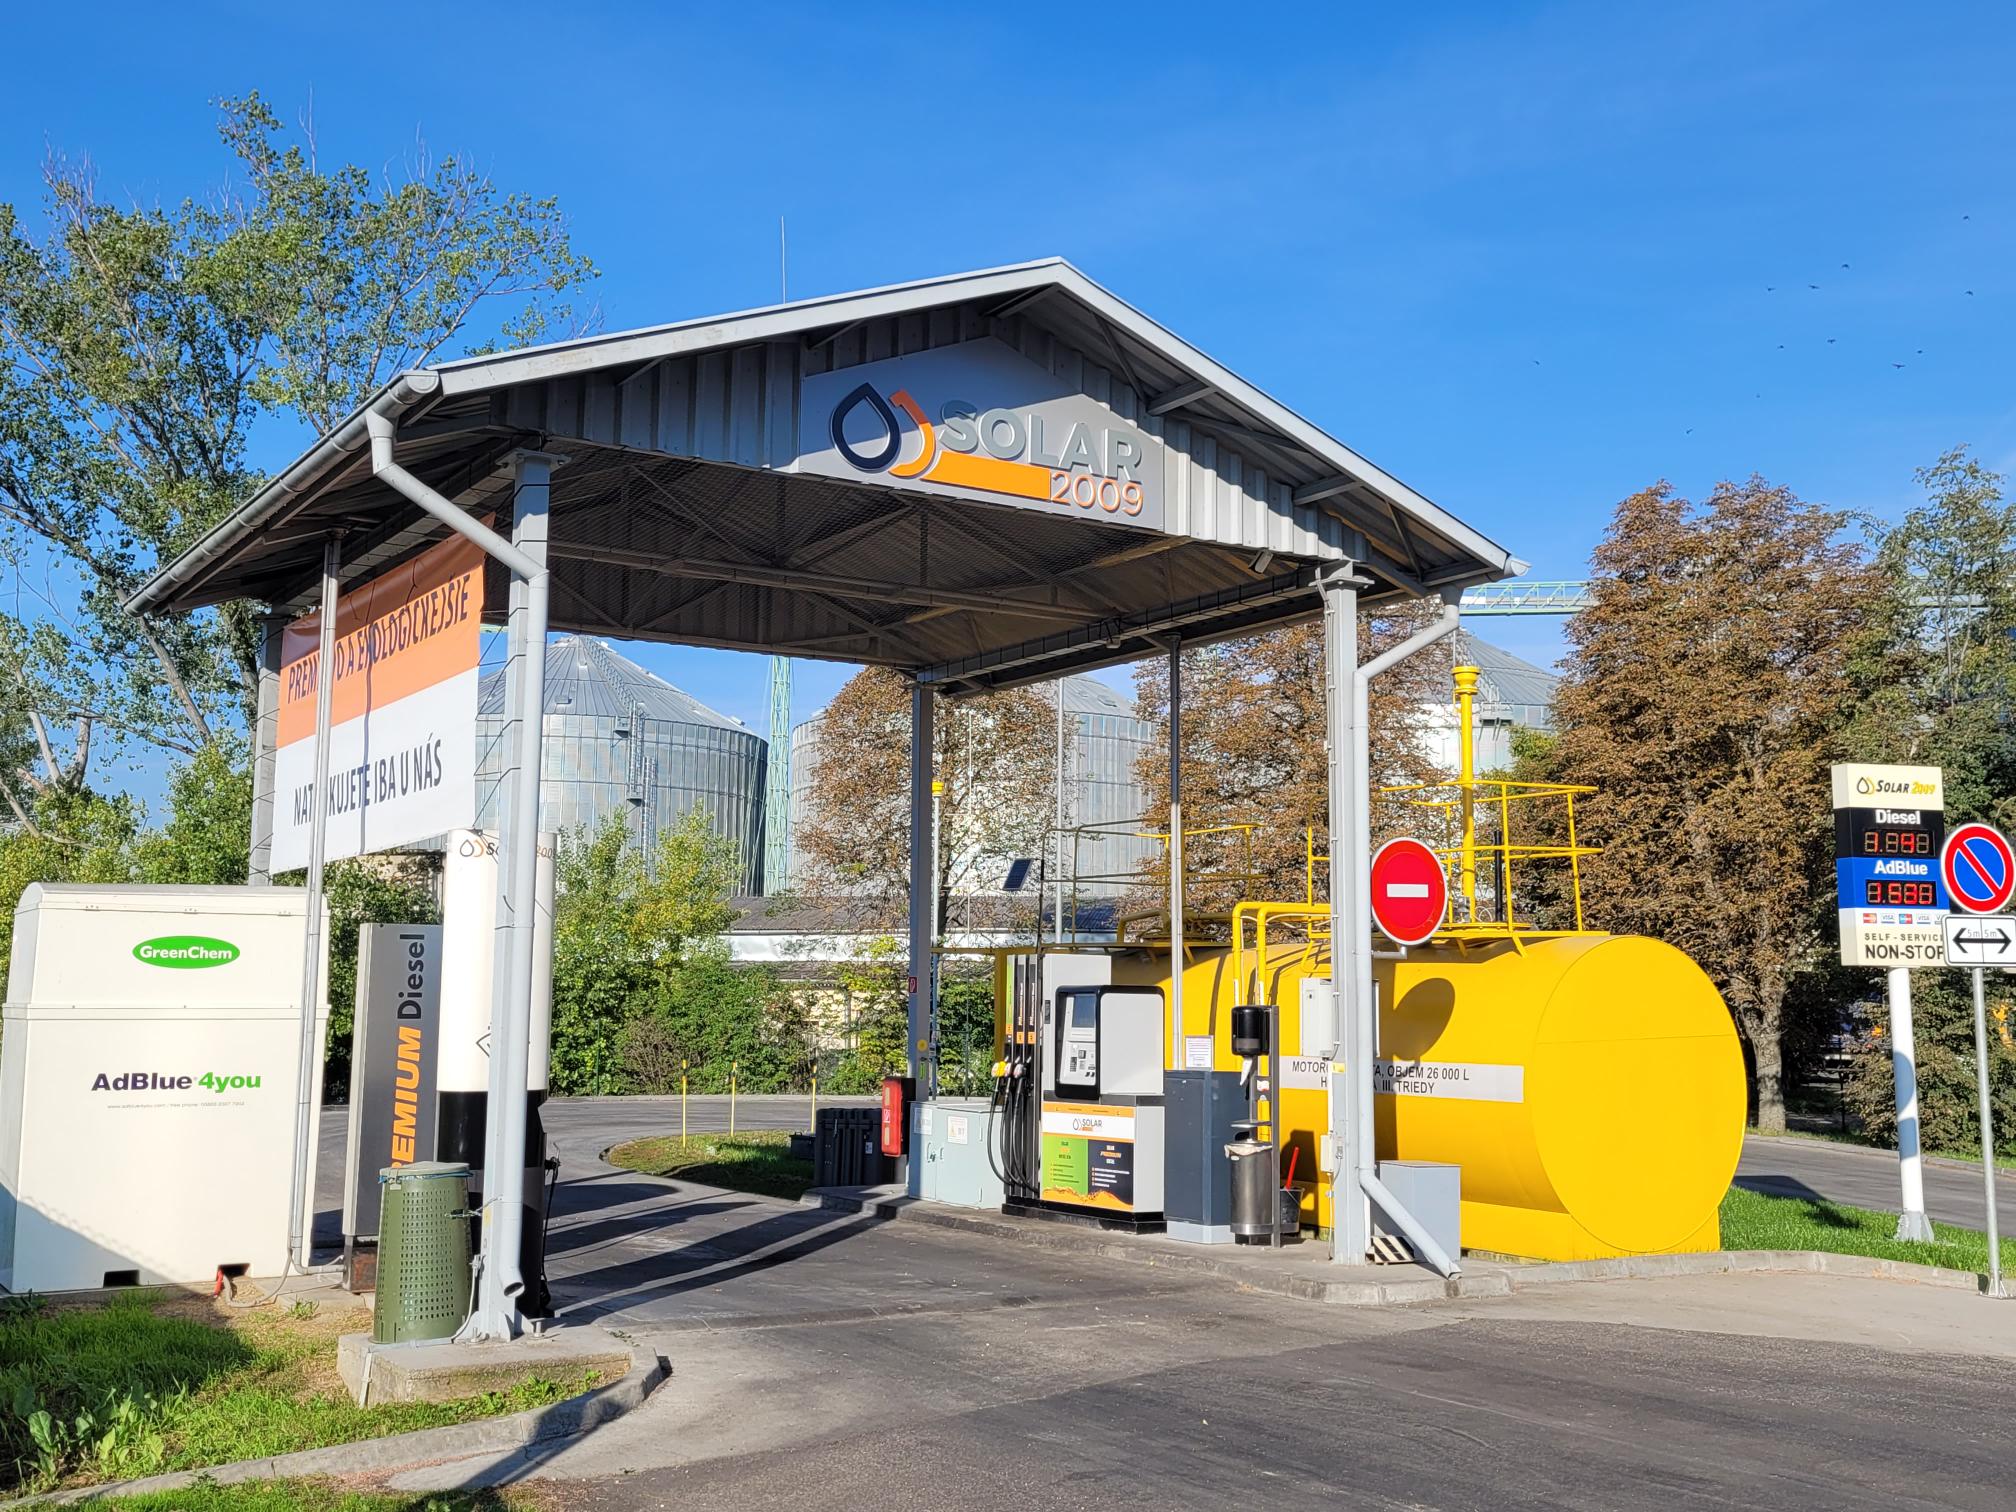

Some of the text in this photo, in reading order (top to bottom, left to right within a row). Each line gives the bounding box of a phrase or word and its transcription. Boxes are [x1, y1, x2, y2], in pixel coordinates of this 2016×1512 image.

[939, 400, 1143, 482] SOLAR
[1051, 470, 1144, 516] 2009
[346, 636, 354, 677] A
[294, 732, 442, 827] NATKUJETE IBA U NÁS
[1876, 780, 1936, 794] SOLAR 2009
[1875, 809, 1921, 824] Diesel
[1873, 860, 1928, 875] AdBlue
[139, 946, 232, 959] GreenChem
[397, 934, 424, 1020] Diesel
[91, 1072, 261, 1093] AdBlue 4you
[1387, 1066, 1423, 1079] OBJEM
[1427, 1067, 1439, 1079] 26
[1442, 1068, 1460, 1080] 000
[1464, 1069, 1470, 1081] L
[1397, 1081, 1434, 1094] TRIEDY
[391, 1026, 421, 1169] EMIUM
[1082, 1118, 1102, 1127] SOLAR
